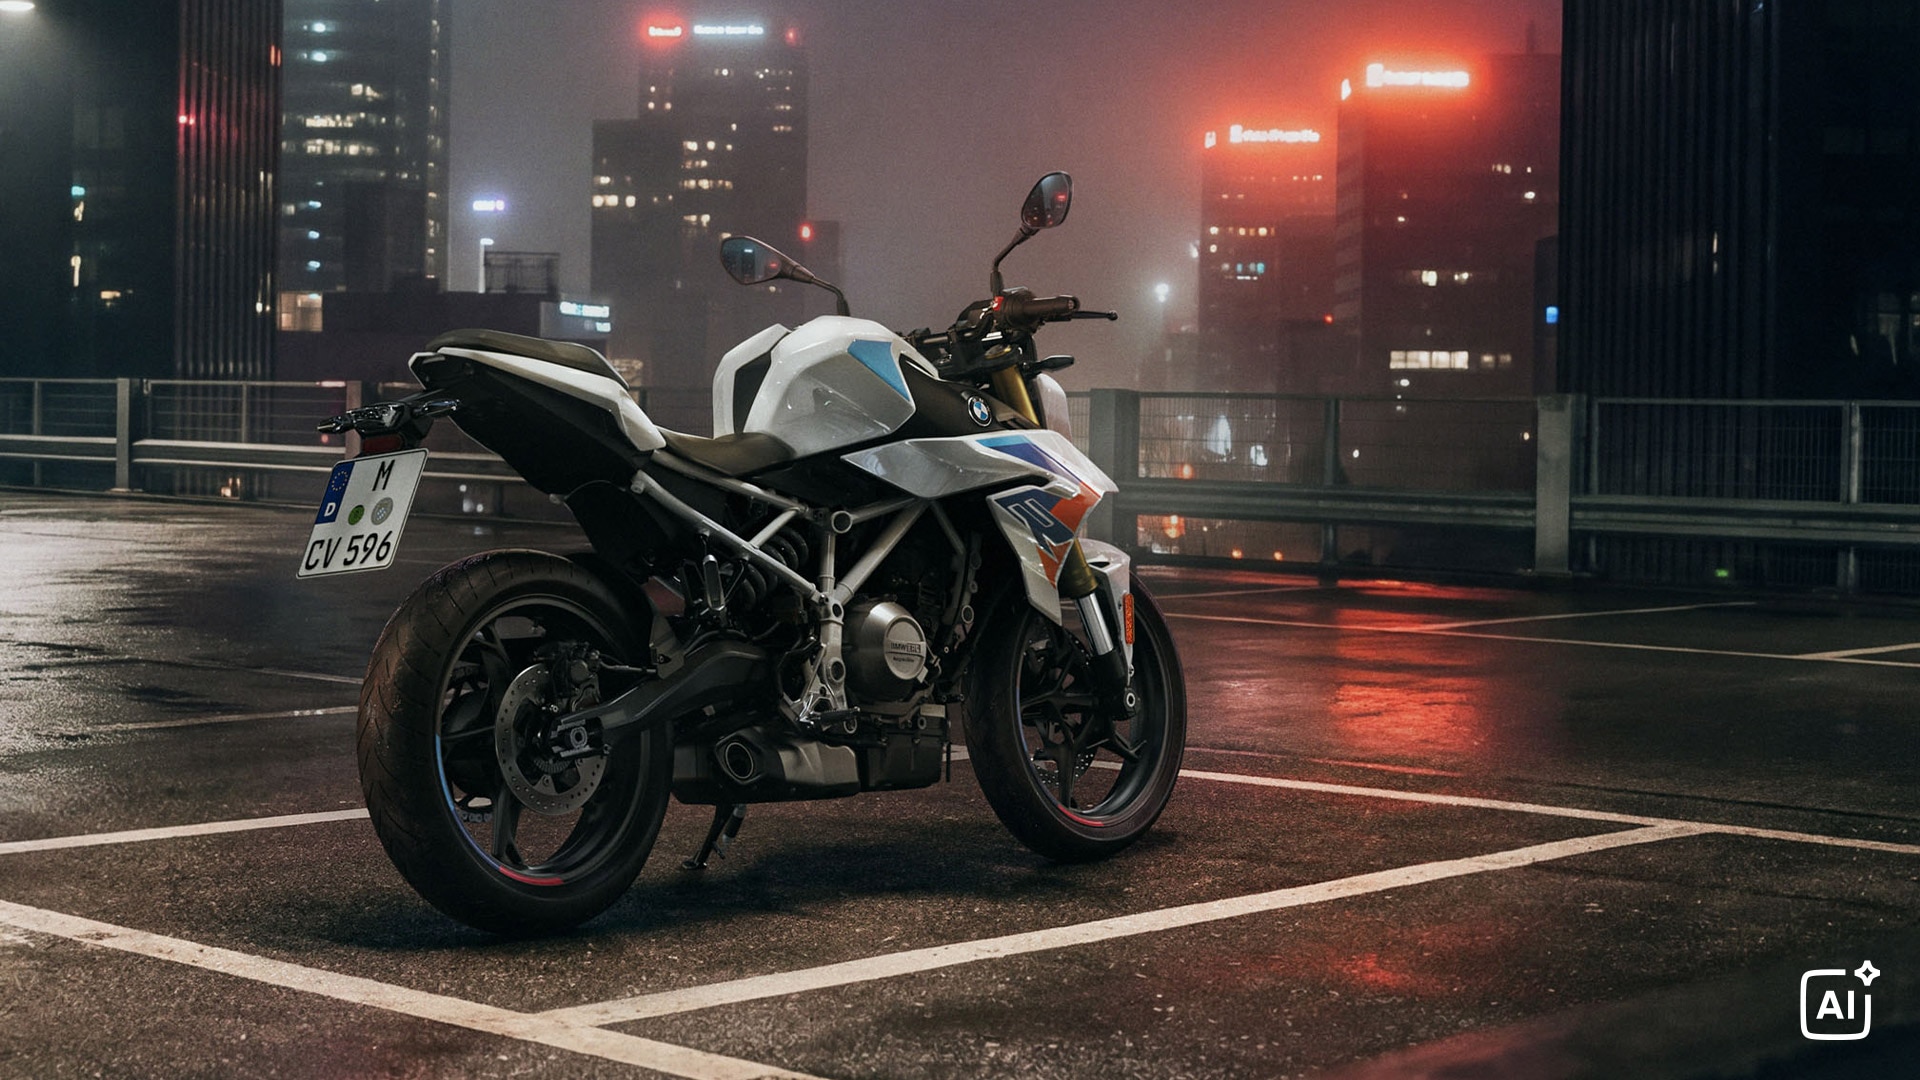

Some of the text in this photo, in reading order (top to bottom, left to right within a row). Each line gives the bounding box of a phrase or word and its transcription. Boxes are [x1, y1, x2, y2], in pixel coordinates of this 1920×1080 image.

[372, 459, 396, 492] M
[323, 502, 336, 517] D
[304, 530, 393, 571] CV 596
